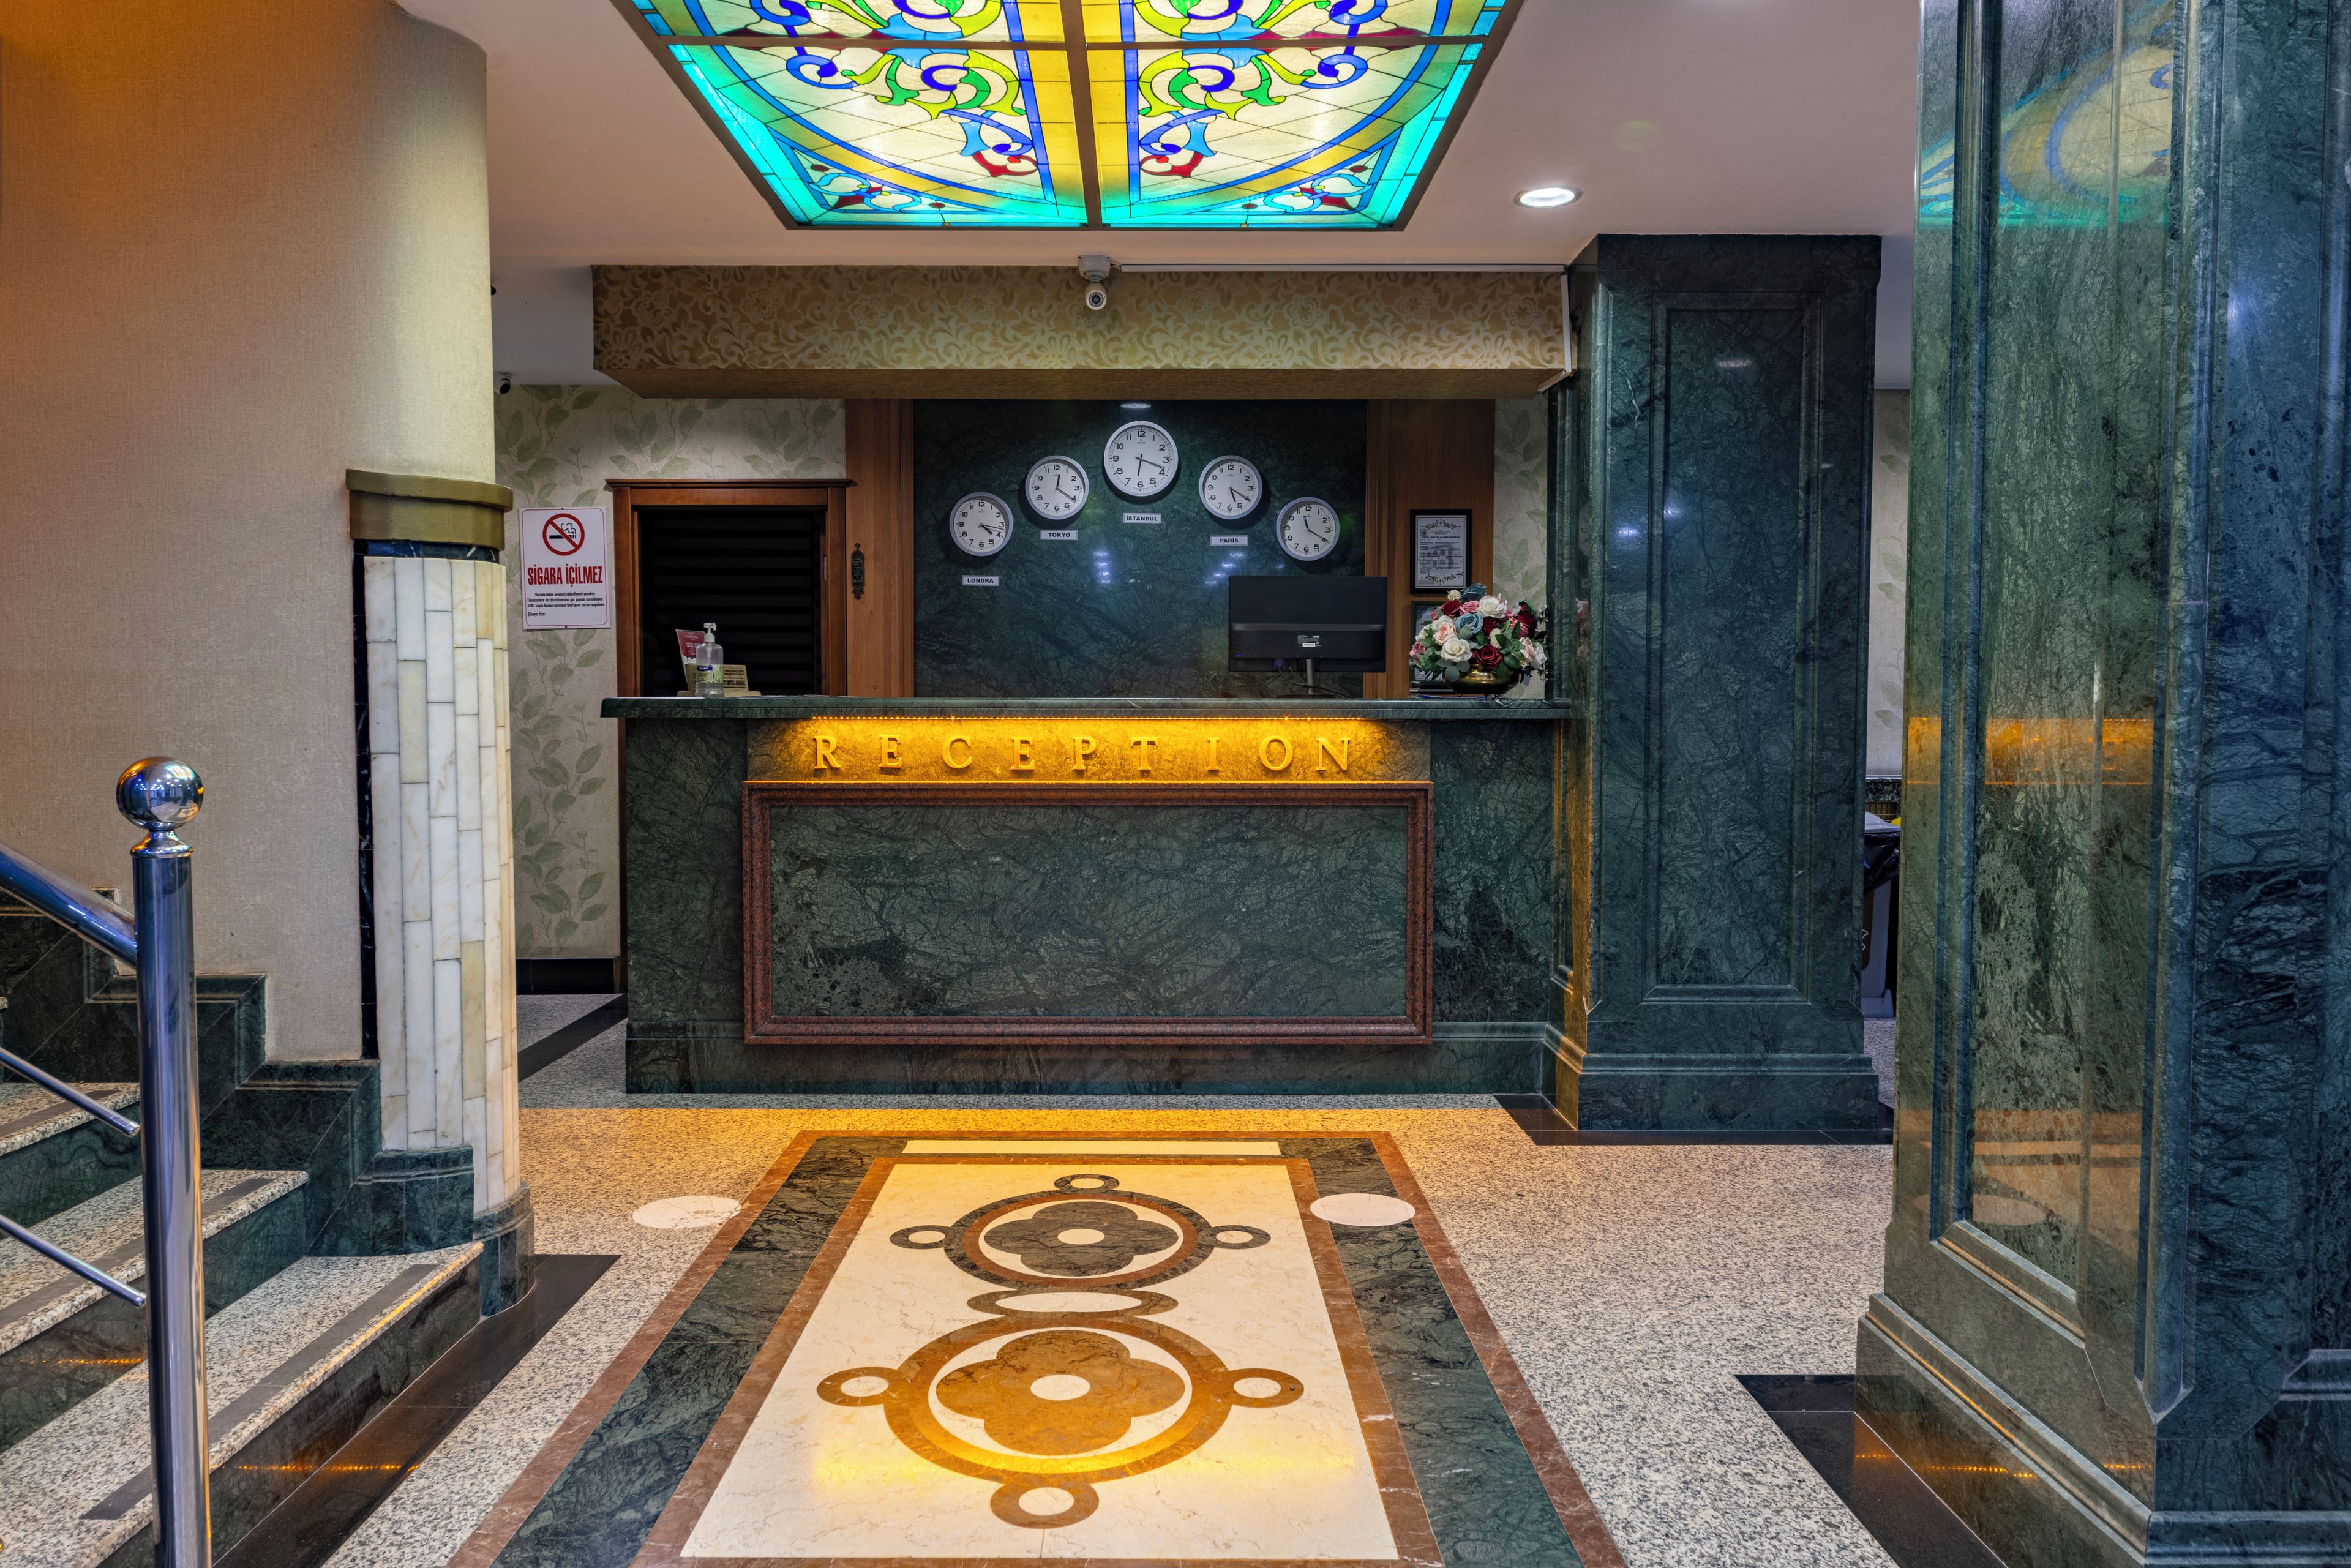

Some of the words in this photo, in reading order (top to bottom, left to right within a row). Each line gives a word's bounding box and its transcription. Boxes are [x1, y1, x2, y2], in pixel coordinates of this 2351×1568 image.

[528, 564, 563, 585] SİGARA
[565, 563, 603, 587] İÇİLMEZ
[813, 735, 1350, 771] RECEPTION
